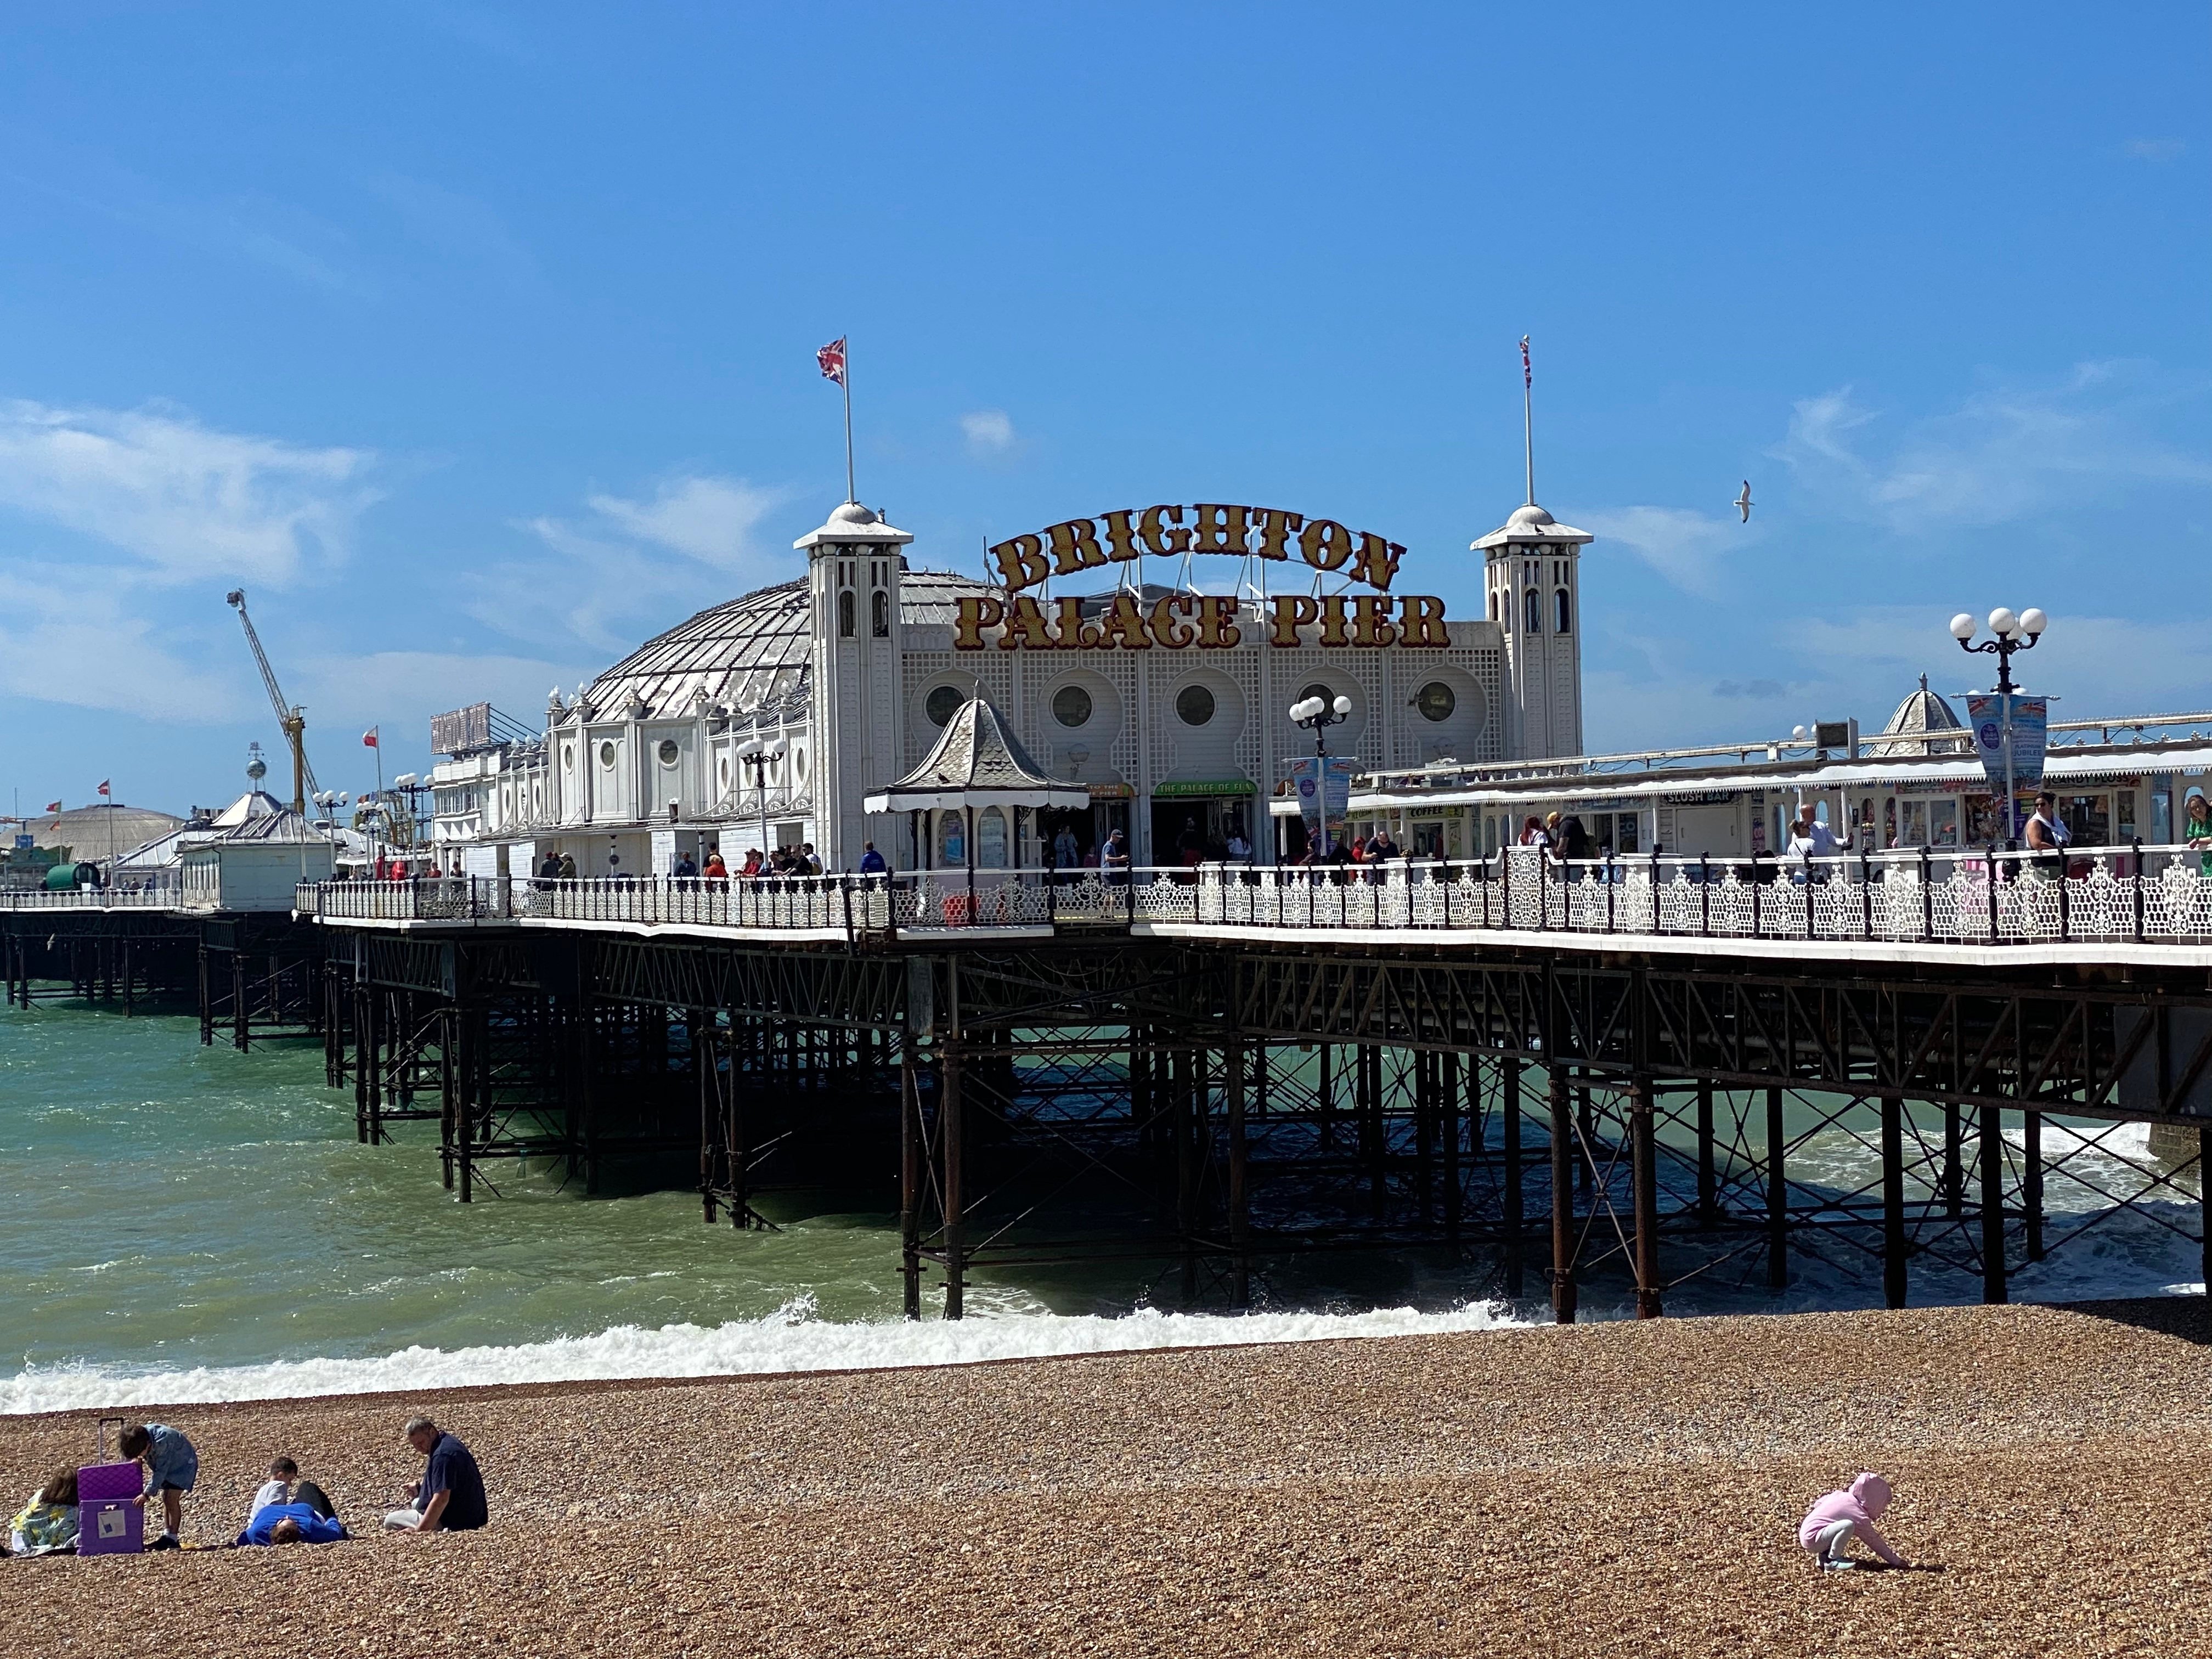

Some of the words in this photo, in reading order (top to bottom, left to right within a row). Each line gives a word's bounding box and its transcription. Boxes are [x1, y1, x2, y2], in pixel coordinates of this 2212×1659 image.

[989, 504, 1407, 593] BRIGHTON
[954, 596, 1242, 651] PALACE
[1271, 595, 1451, 649] PIER
[1160, 785, 1176, 793] THE
[1181, 784, 1214, 792] PALACE
[1218, 783, 1229, 792] OF
[1234, 782, 1252, 791] FUN
[1668, 791, 1703, 803] SLUSH
[1707, 790, 1729, 801] BAR
[1410, 805, 1443, 817] COFFEE
